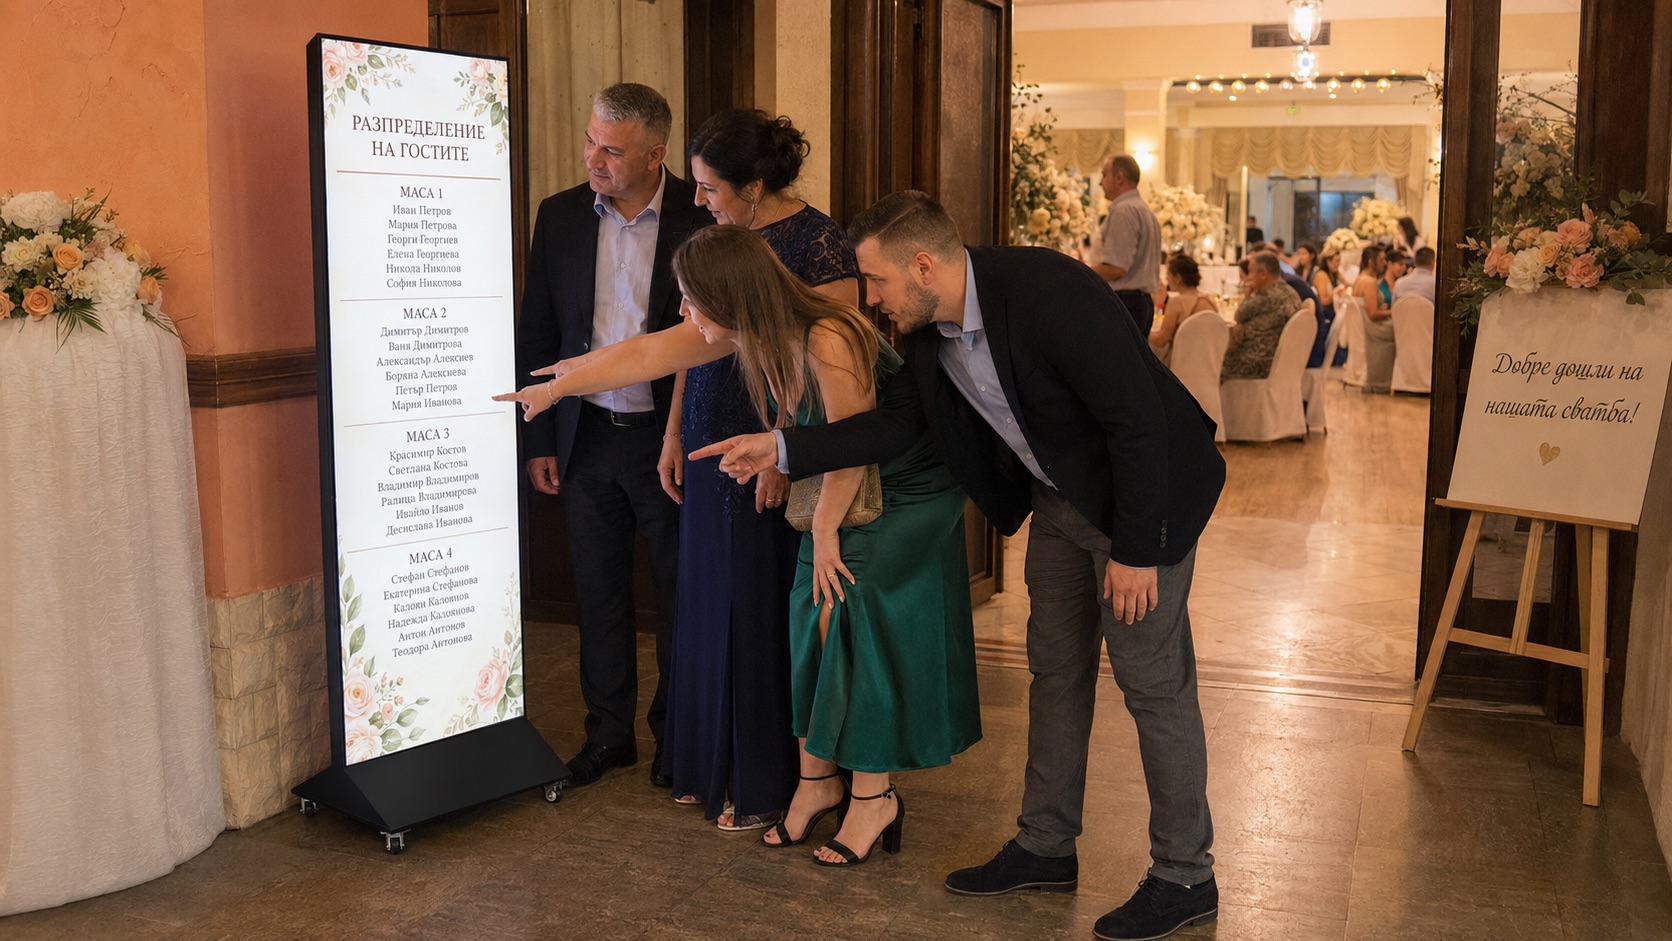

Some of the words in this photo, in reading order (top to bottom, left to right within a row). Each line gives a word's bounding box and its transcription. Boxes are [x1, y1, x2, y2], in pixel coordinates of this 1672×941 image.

[352, 115, 485, 139] РАЗПРЕДЕЛЕНИЕ
[372, 141, 395, 157] НА
[400, 143, 469, 161] ГОСТИТЕ
[400, 186, 434, 198] МАСА
[438, 188, 443, 199] 1
[393, 205, 416, 215] Иван
[419, 206, 451, 217] Петров
[388, 220, 418, 231] Мария
[421, 221, 457, 231] Петрова
[388, 235, 417, 246] Георги
[420, 235, 458, 246] Георгиев
[388, 250, 414, 259] Елена
[417, 250, 459, 260] Георгиева
[386, 264, 420, 273] Никола
[423, 264, 461, 273] Николов
[387, 279, 416, 289] София
[419, 278, 461, 287] Николова
[404, 308, 437, 319] МАСА
[441, 308, 447, 318] 2
[380, 327, 422, 337] Димитър
[424, 326, 468, 335] Димитров
[389, 342, 410, 351] Ваня
[413, 340, 462, 351] Димитрова
[433, 354, 474, 363] Алексиев
[386, 371, 418, 382] Боряна
[421, 368, 466, 378] Алексиева
[1492, 352, 1551, 383] Добре
[1552, 362, 1615, 385] дошли
[1619, 366, 1643, 380] на
[396, 386, 423, 396] Петър
[426, 384, 457, 394] Петров
[392, 401, 422, 411] Мария
[424, 398, 462, 408] Иванова
[1485, 399, 1557, 419] нашата
[1561, 397, 1640, 423] сватба!
[407, 429, 440, 442] МАСА
[444, 428, 450, 439] 3
[390, 450, 434, 462] Красимир
[437, 445, 466, 455] Костов
[389, 464, 431, 475] Светлана
[434, 460, 468, 470] Костова
[378, 479, 423, 492] Владимир
[426, 473, 479, 485] Владимиров
[381, 496, 415, 506] Ралица
[419, 488, 476, 502] Владимирова
[396, 508, 429, 519] Ивайло
[432, 504, 463, 515] Иванов
[386, 523, 433, 537] Десислава
[436, 516, 472, 528] Иванова
[410, 550, 442, 564] МАСА
[447, 548, 452, 558] 4
[391, 571, 425, 584] Стефан
[428, 565, 469, 578] Стефанов
[384, 586, 430, 600] Екатерина
[432, 577, 478, 592] Стефанова
[394, 602, 426, 613] Калоян
[388, 616, 428, 629] Надежда
[430, 606, 475, 620] Калоянова
[398, 630, 427, 642] Антон
[429, 622, 465, 636] Антонов
[392, 644, 429, 658] Теодора
[431, 634, 472, 649] Антонова
